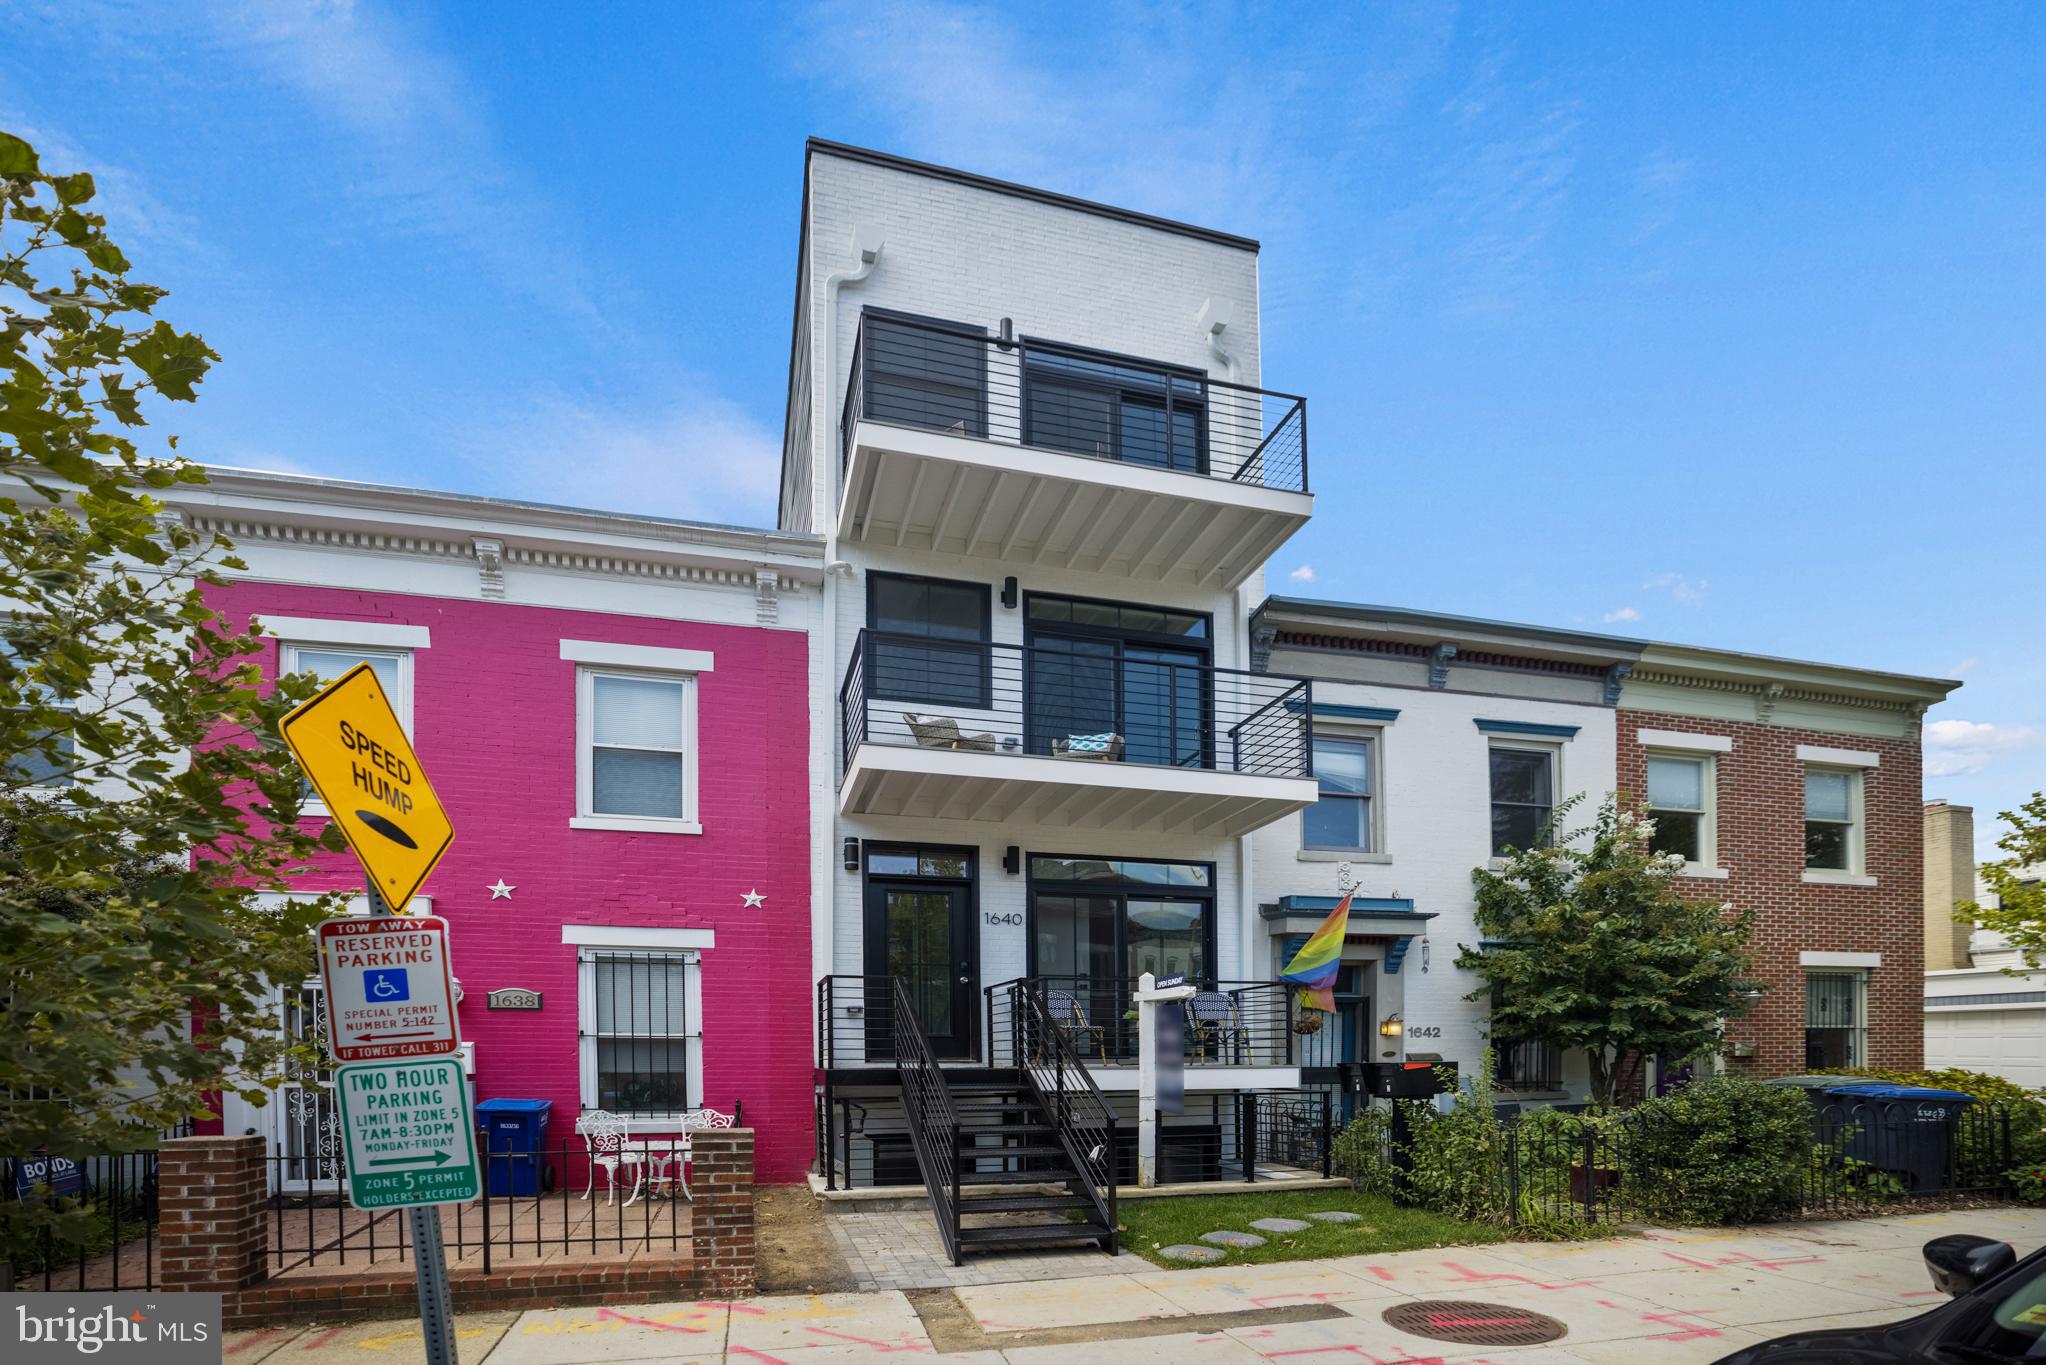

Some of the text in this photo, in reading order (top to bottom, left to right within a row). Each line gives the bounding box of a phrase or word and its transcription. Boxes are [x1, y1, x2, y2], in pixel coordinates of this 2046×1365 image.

[339, 720, 411, 785] SPEED
[352, 761, 413, 815] HUMP
[336, 920, 427, 934] TOW AWAY
[984, 912, 1023, 926] 1640
[335, 934, 433, 952] RESERVED
[338, 950, 433, 968] PARKING
[494, 995, 535, 1007] 1638
[344, 1005, 438, 1019] SPECIAL PERMIT
[346, 1016, 435, 1031] NUMBER 5-142
[1408, 1026, 1441, 1038] 1642
[343, 1041, 449, 1058] IF TOWED CALL 311
[350, 1068, 449, 1092] TWO HOUR
[367, 1090, 442, 1109] PARKING
[356, 1107, 459, 1127] LIMIT IN ZONE 5
[360, 1123, 455, 1141] 7AM-8:30PM
[365, 1137, 454, 1153] MONDAY-FRIDAY
[365, 1172, 465, 1190] ZONE 5 PERMIT
[363, 1187, 472, 1205] HOLDERS EXCEPTED
